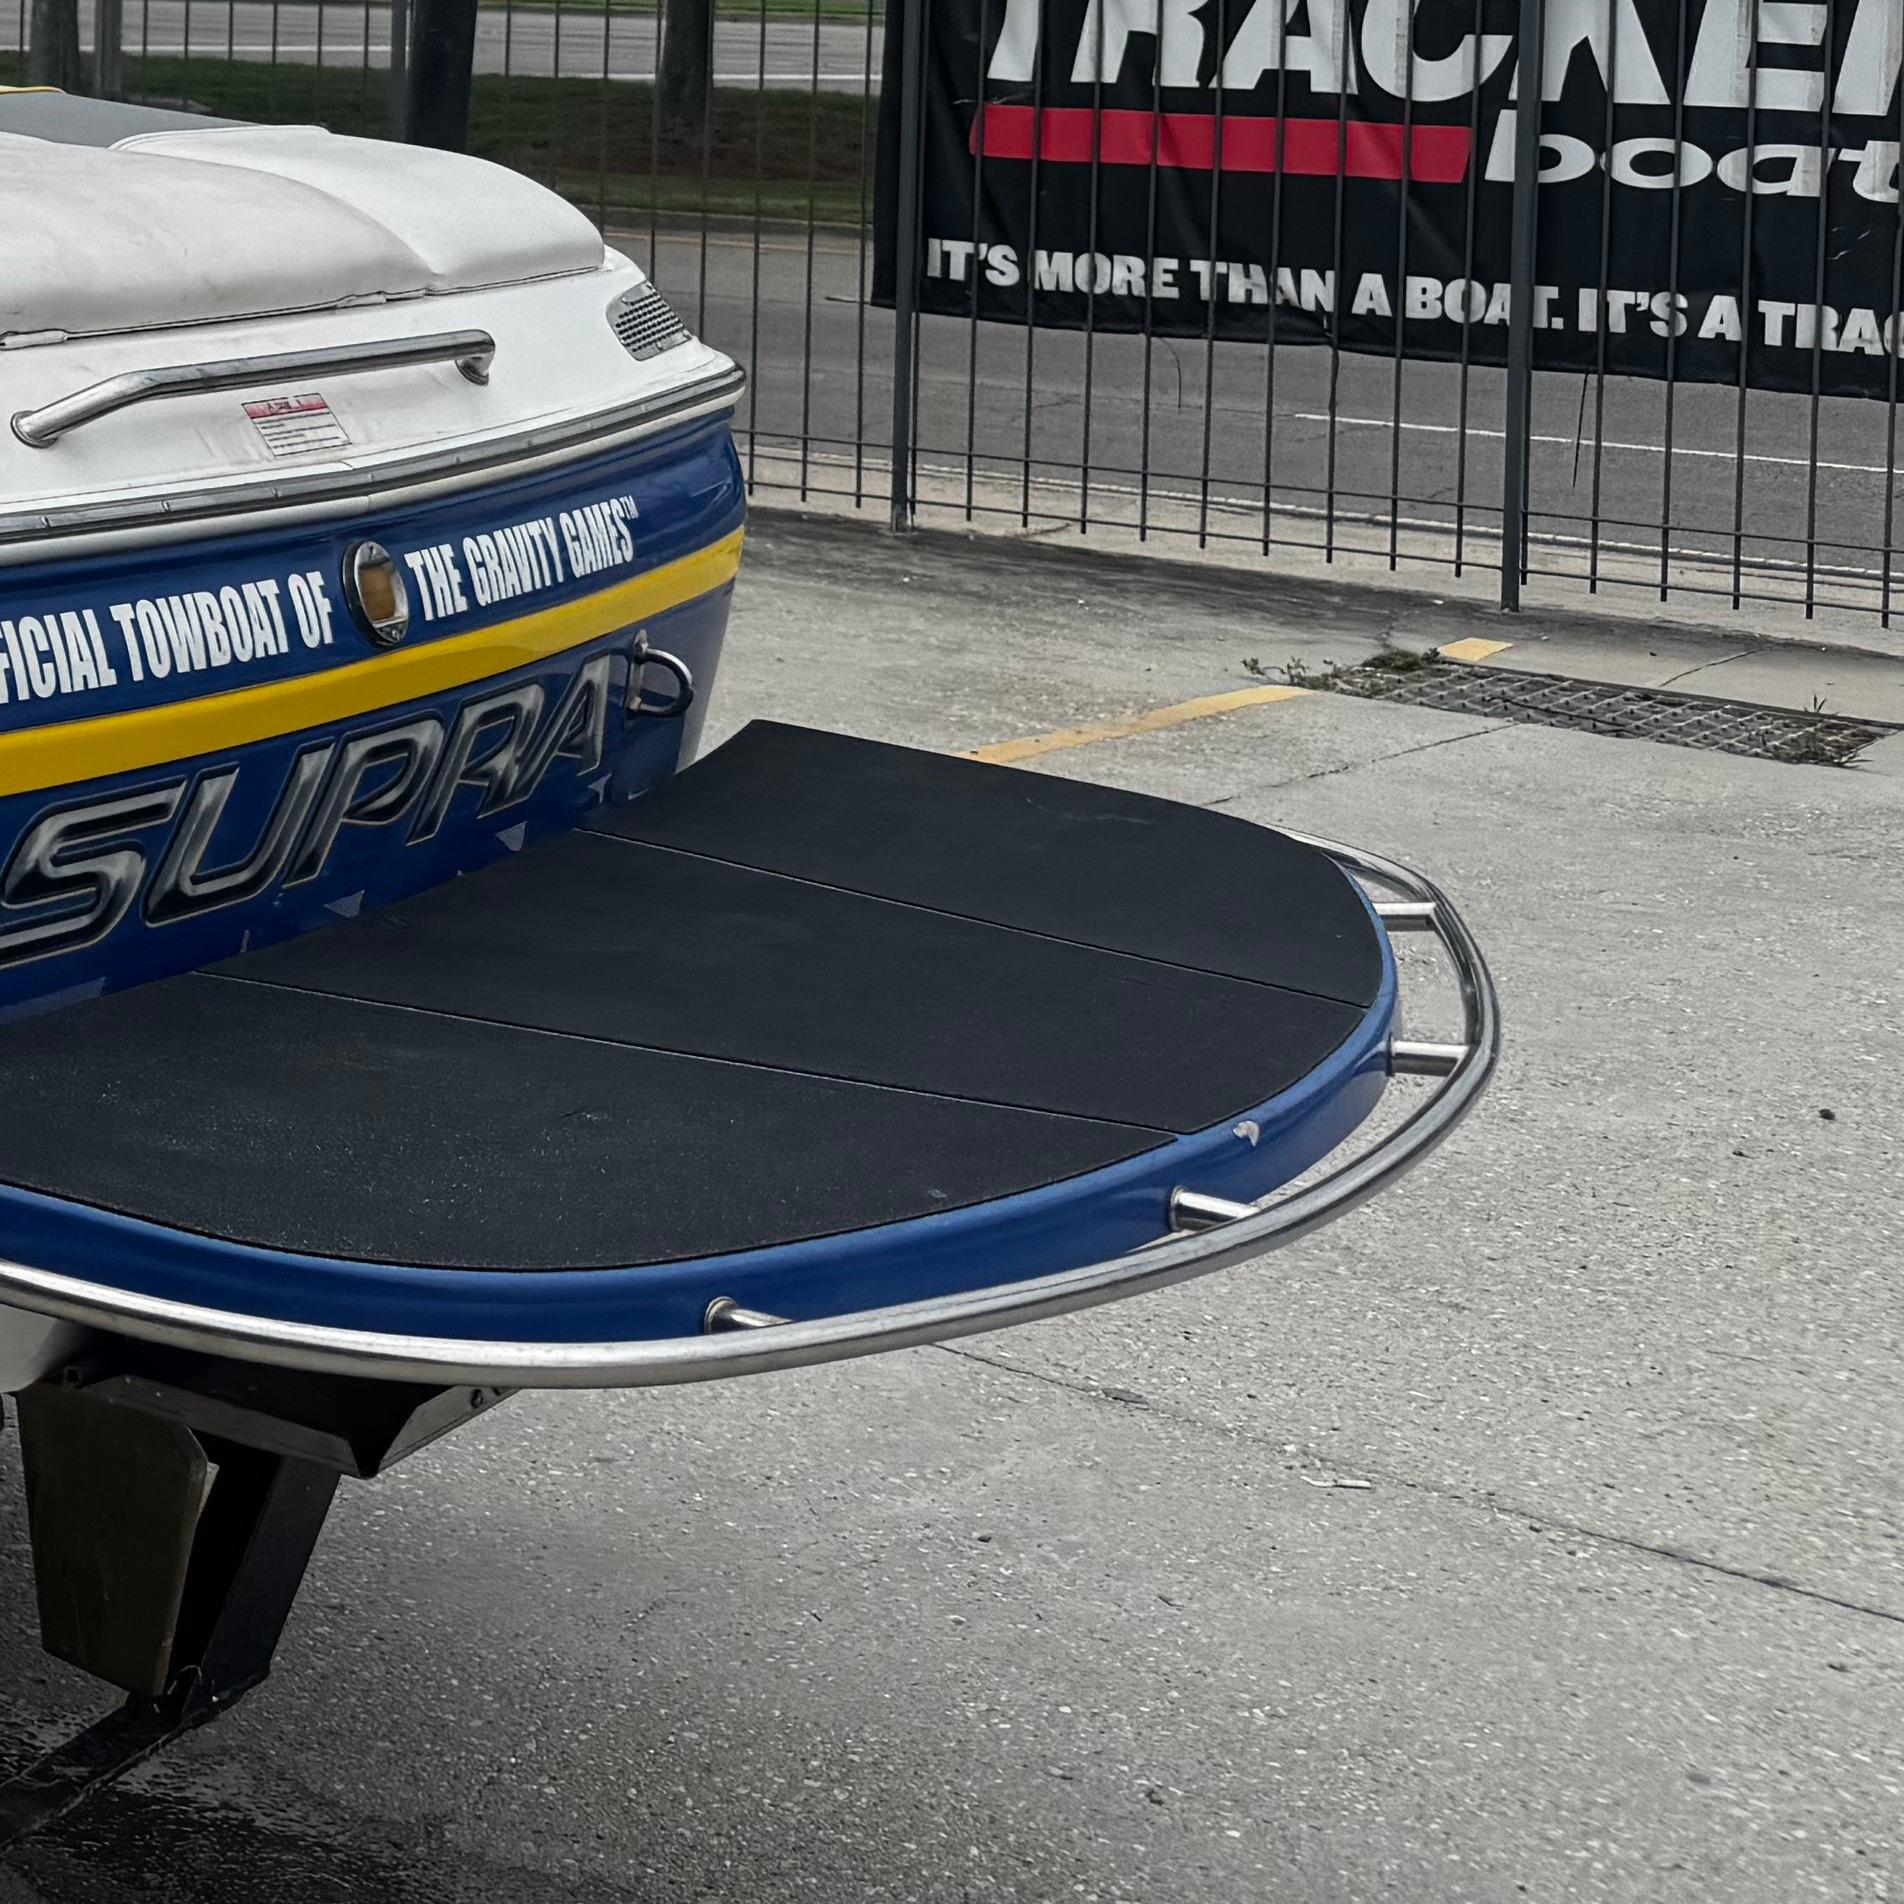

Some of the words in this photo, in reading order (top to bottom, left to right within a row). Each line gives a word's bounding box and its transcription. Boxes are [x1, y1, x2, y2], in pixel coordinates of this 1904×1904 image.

[926, 238, 1020, 287] IT'S
[1034, 249, 1180, 300] MORE
[1189, 259, 1335, 313] THAN
[1351, 273, 1392, 317] A
[1406, 276, 1564, 330] BOAT.
[1578, 288, 1689, 338] IT'S
[1697, 294, 1743, 342] A
[109, 579, 287, 682] TOWBOAT
[287, 571, 333, 649] OF
[404, 543, 469, 622] THE
[462, 517, 565, 607] GRAVITY
